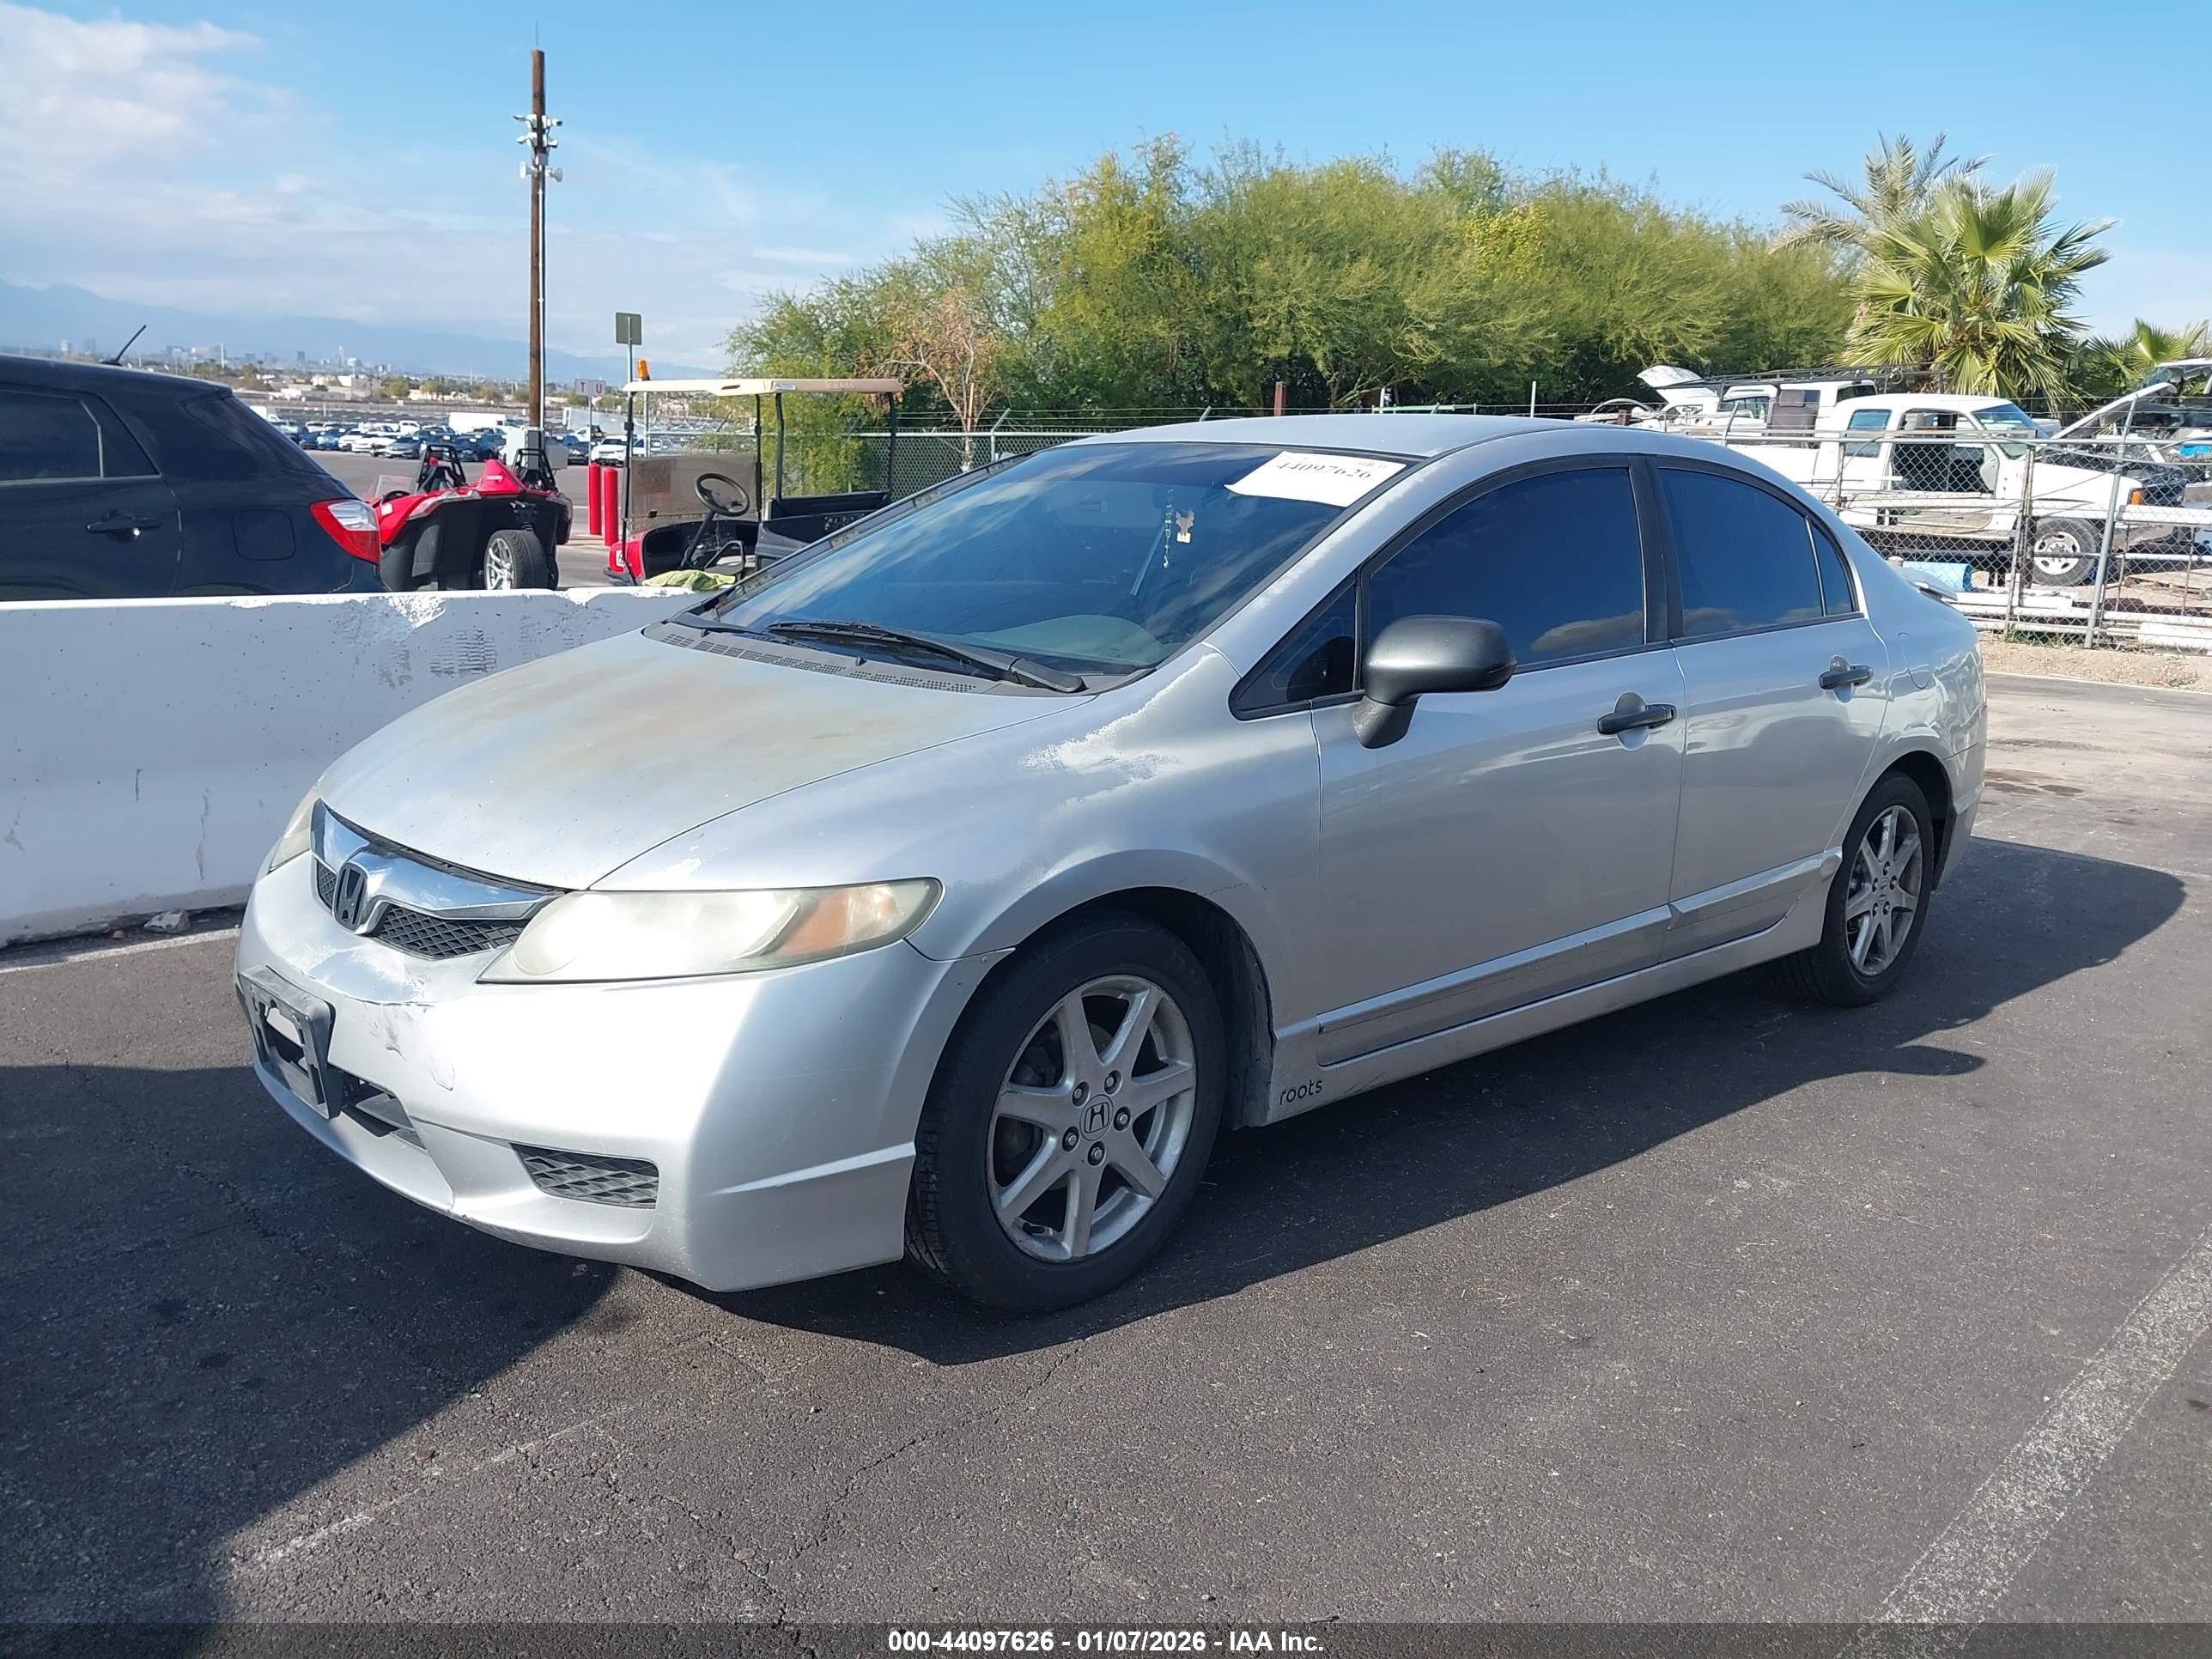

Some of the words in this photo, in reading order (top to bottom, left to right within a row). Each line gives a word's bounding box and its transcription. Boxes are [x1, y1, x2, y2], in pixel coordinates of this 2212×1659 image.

[580, 382, 586, 392] T
[596, 383, 602, 394] U
[1279, 1079, 1323, 1105] roots
